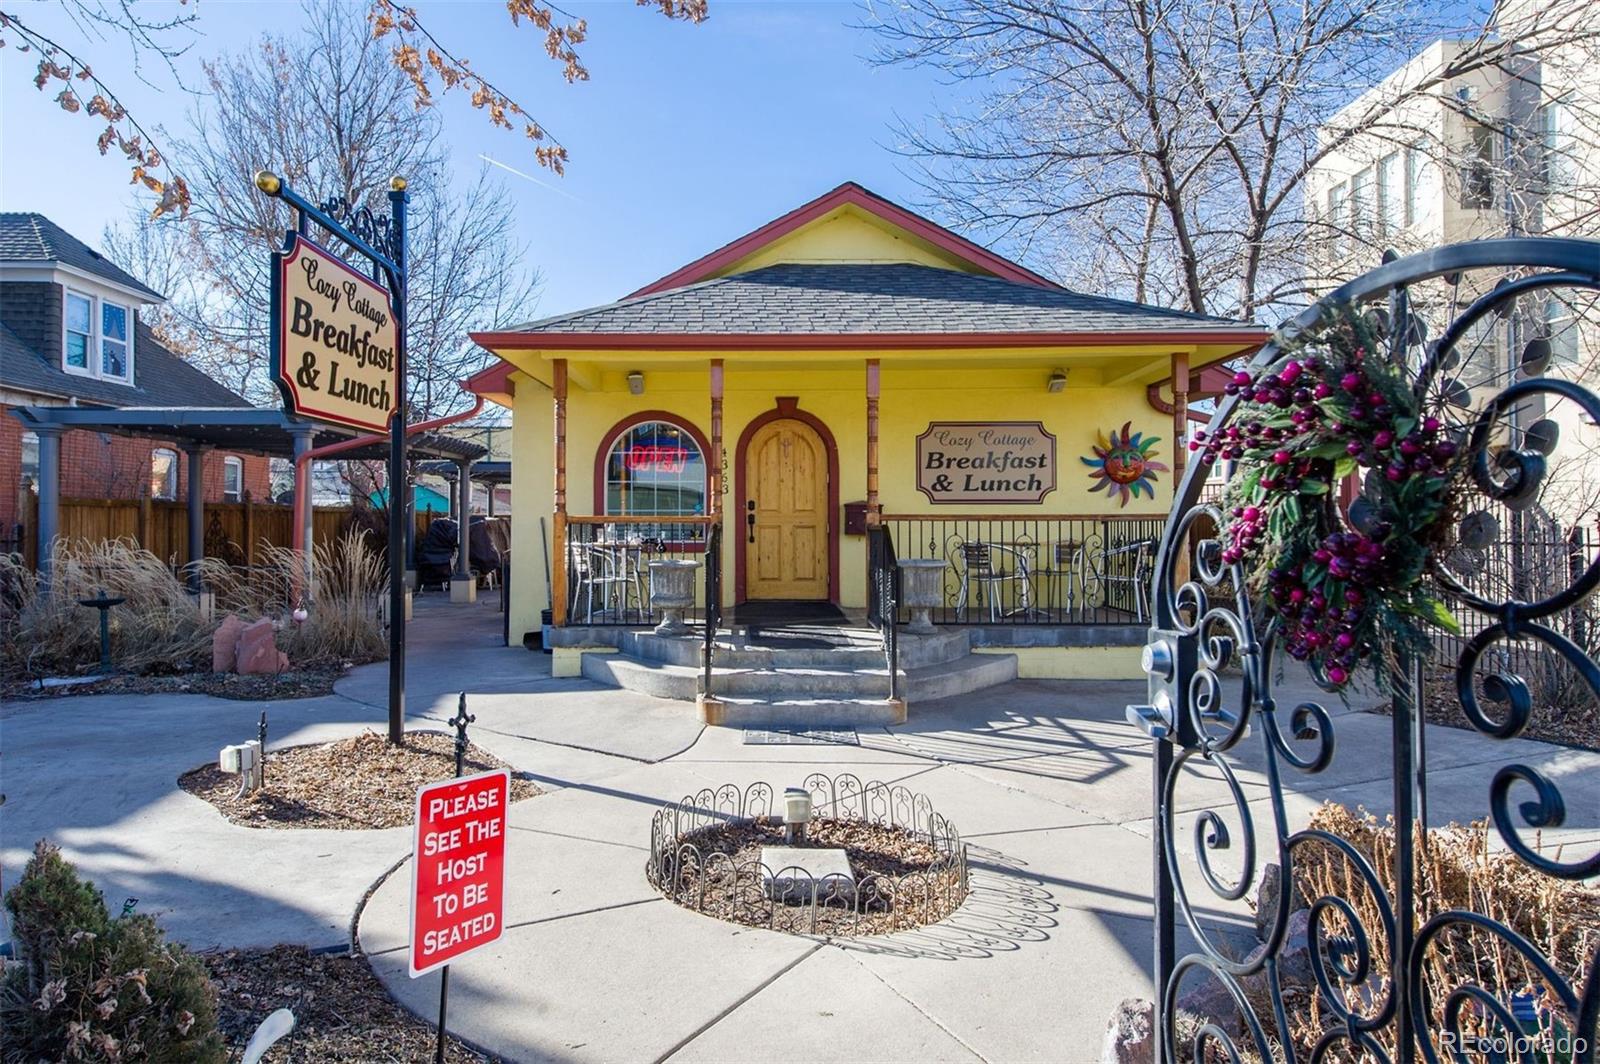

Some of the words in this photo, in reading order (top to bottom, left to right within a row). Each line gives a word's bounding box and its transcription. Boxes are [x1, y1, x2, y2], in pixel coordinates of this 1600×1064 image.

[301, 257, 341, 312] Cozy
[343, 280, 387, 333] Cottage
[291, 297, 394, 372] Breakfast
[297, 351, 320, 391] &
[328, 361, 390, 411] Lunch
[934, 430, 974, 450] Cozy
[978, 429, 1036, 450] Cottage
[925, 451, 1047, 472] Breakfast
[931, 474, 953, 492] &
[964, 474, 1042, 492] Lunch
[429, 788, 499, 823] PLEASE
[424, 828, 462, 856] SEE
[465, 818, 501, 844] THE
[437, 852, 488, 885] HOST
[433, 893, 458, 919] TO
[463, 882, 489, 909] BE
[423, 912, 496, 956] SEATED
